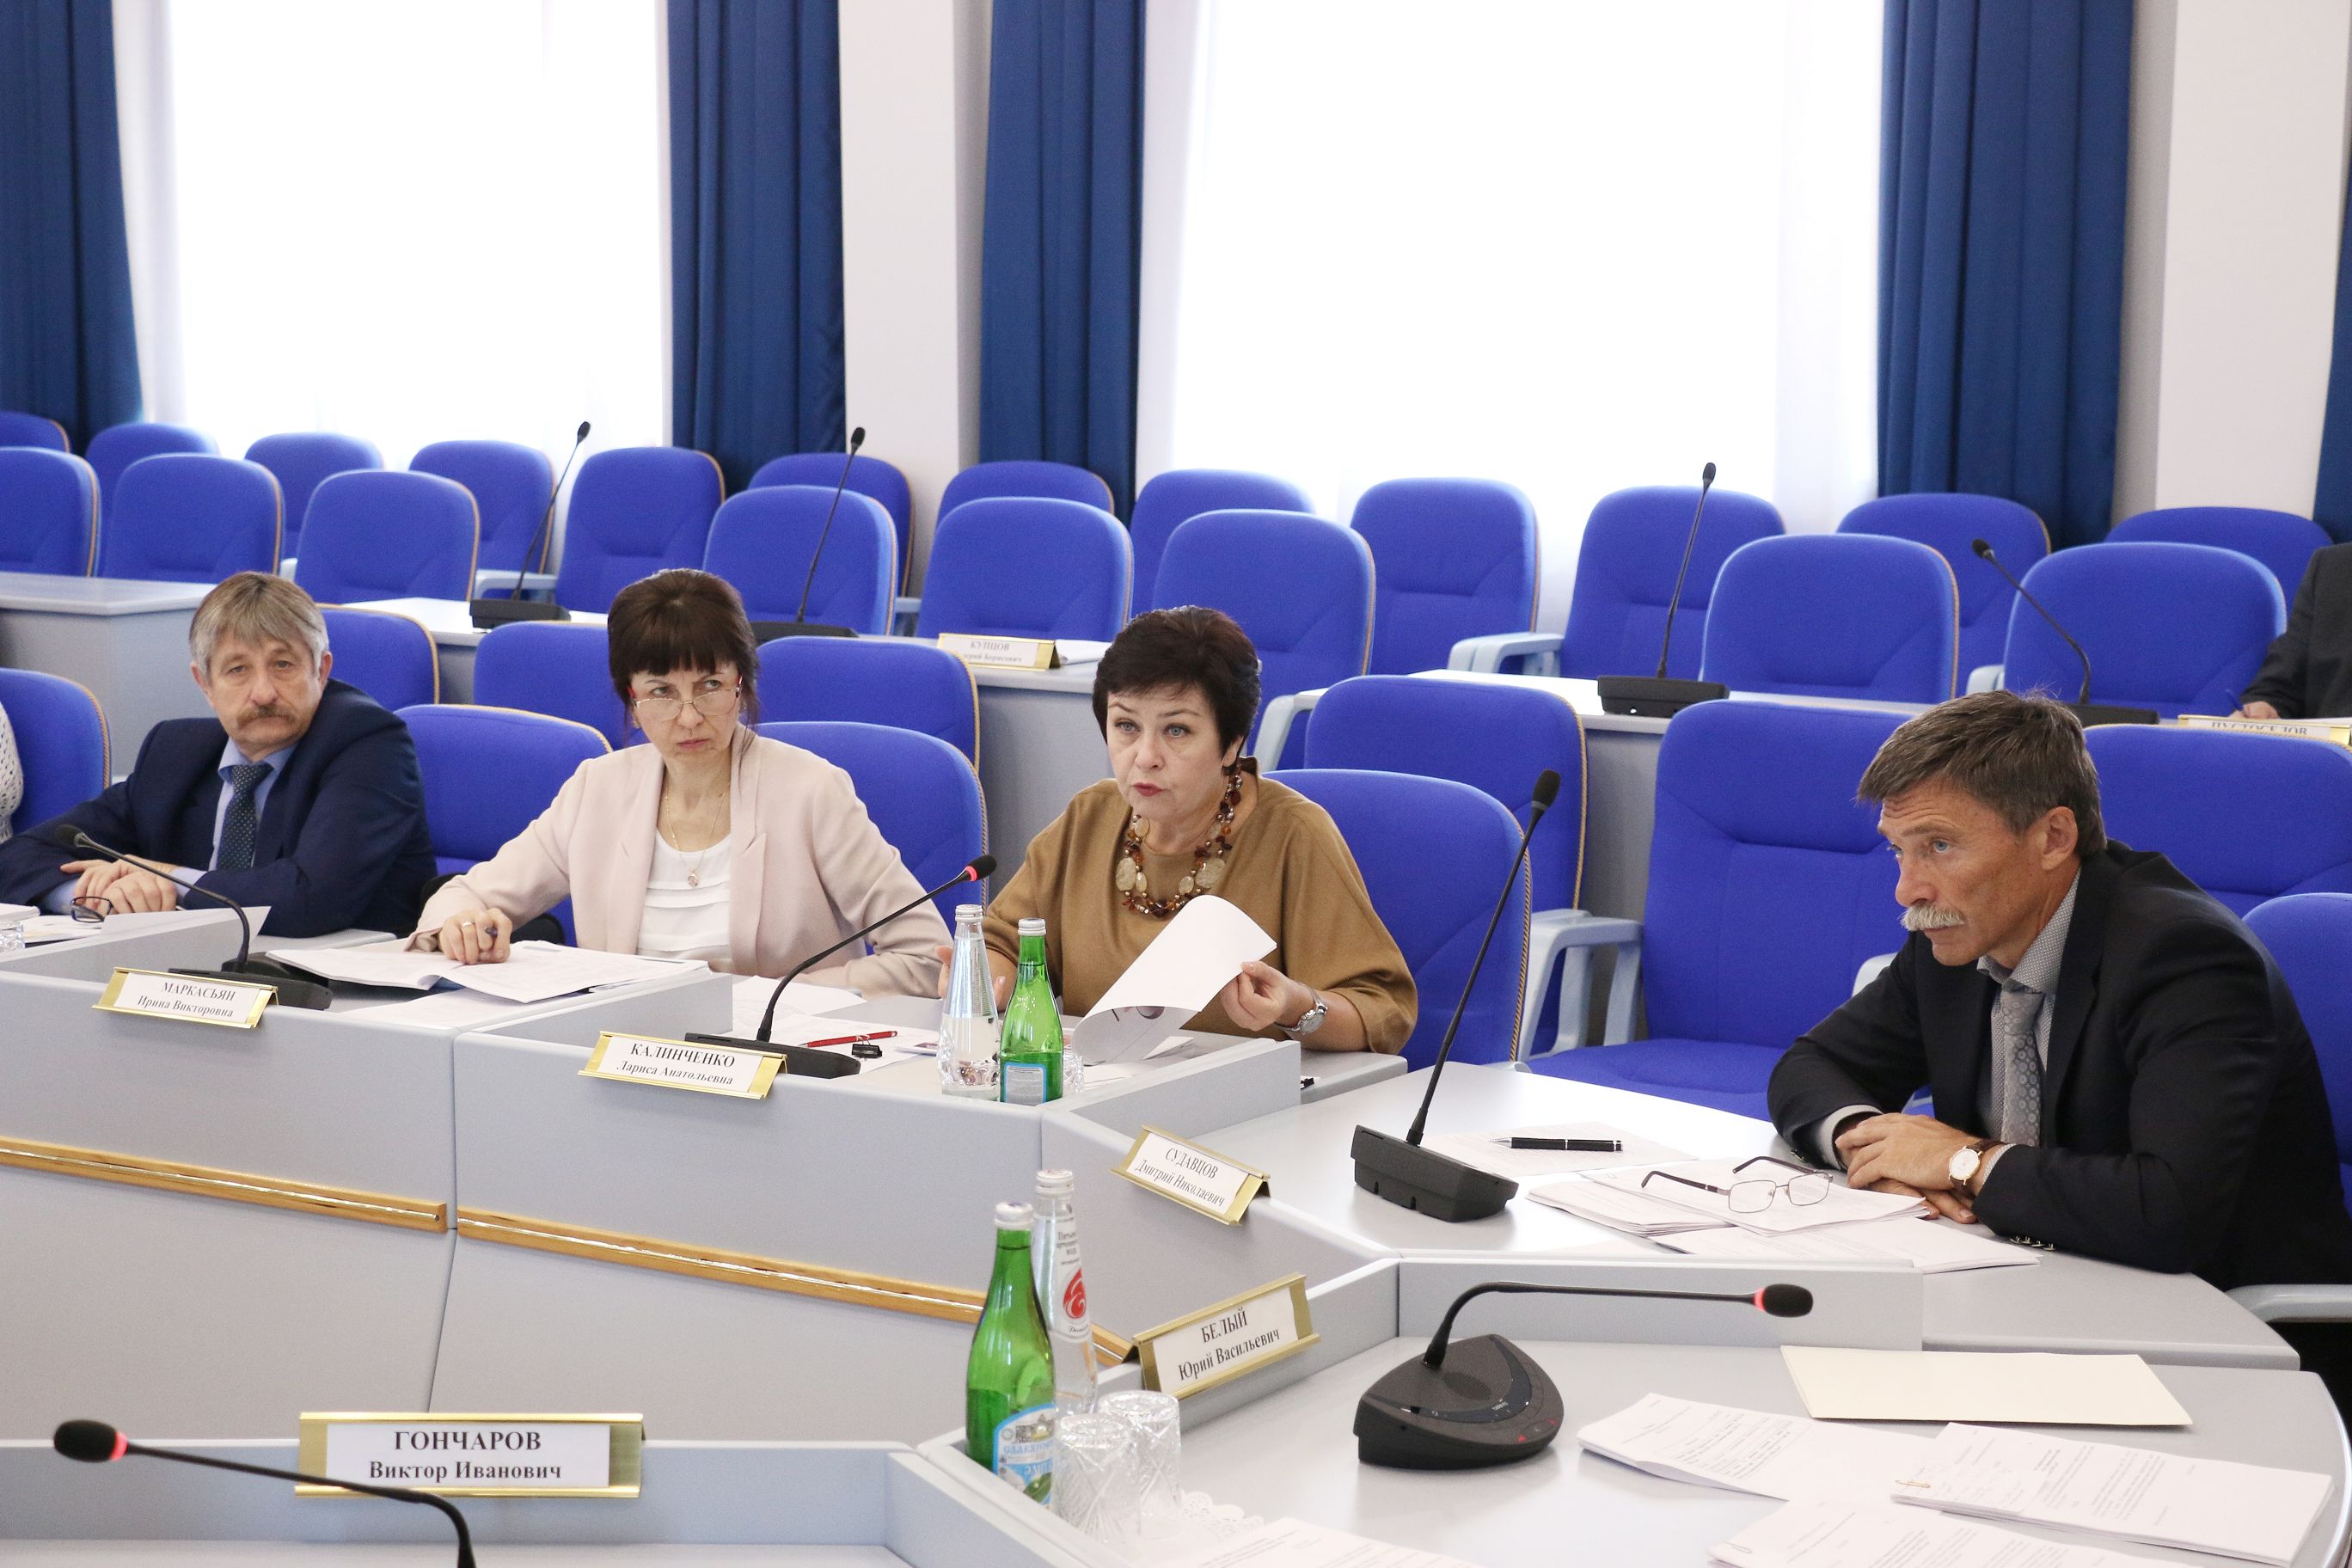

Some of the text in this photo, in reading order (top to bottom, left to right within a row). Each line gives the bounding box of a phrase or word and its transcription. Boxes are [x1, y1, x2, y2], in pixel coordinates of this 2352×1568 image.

[161, 982, 236, 1001] МАРКАСЬЯН
[138, 995, 234, 1018] Ирина Викторовна
[630, 1043, 735, 1068] КАЛИНЧЕНКО
[616, 1060, 733, 1085] Лариса Анатольевна
[1165, 1148, 1219, 1179] СУДАВЦОВ
[1135, 1159, 1225, 1207] Дмитрий Николаевич
[1201, 1307, 1247, 1344] БЕЛЫЙ
[1179, 1328, 1280, 1381] Юрий Васильевич
[394, 1430, 542, 1451] ГОНЧАРОВ
[369, 1461, 562, 1484] Виктор Иванович
